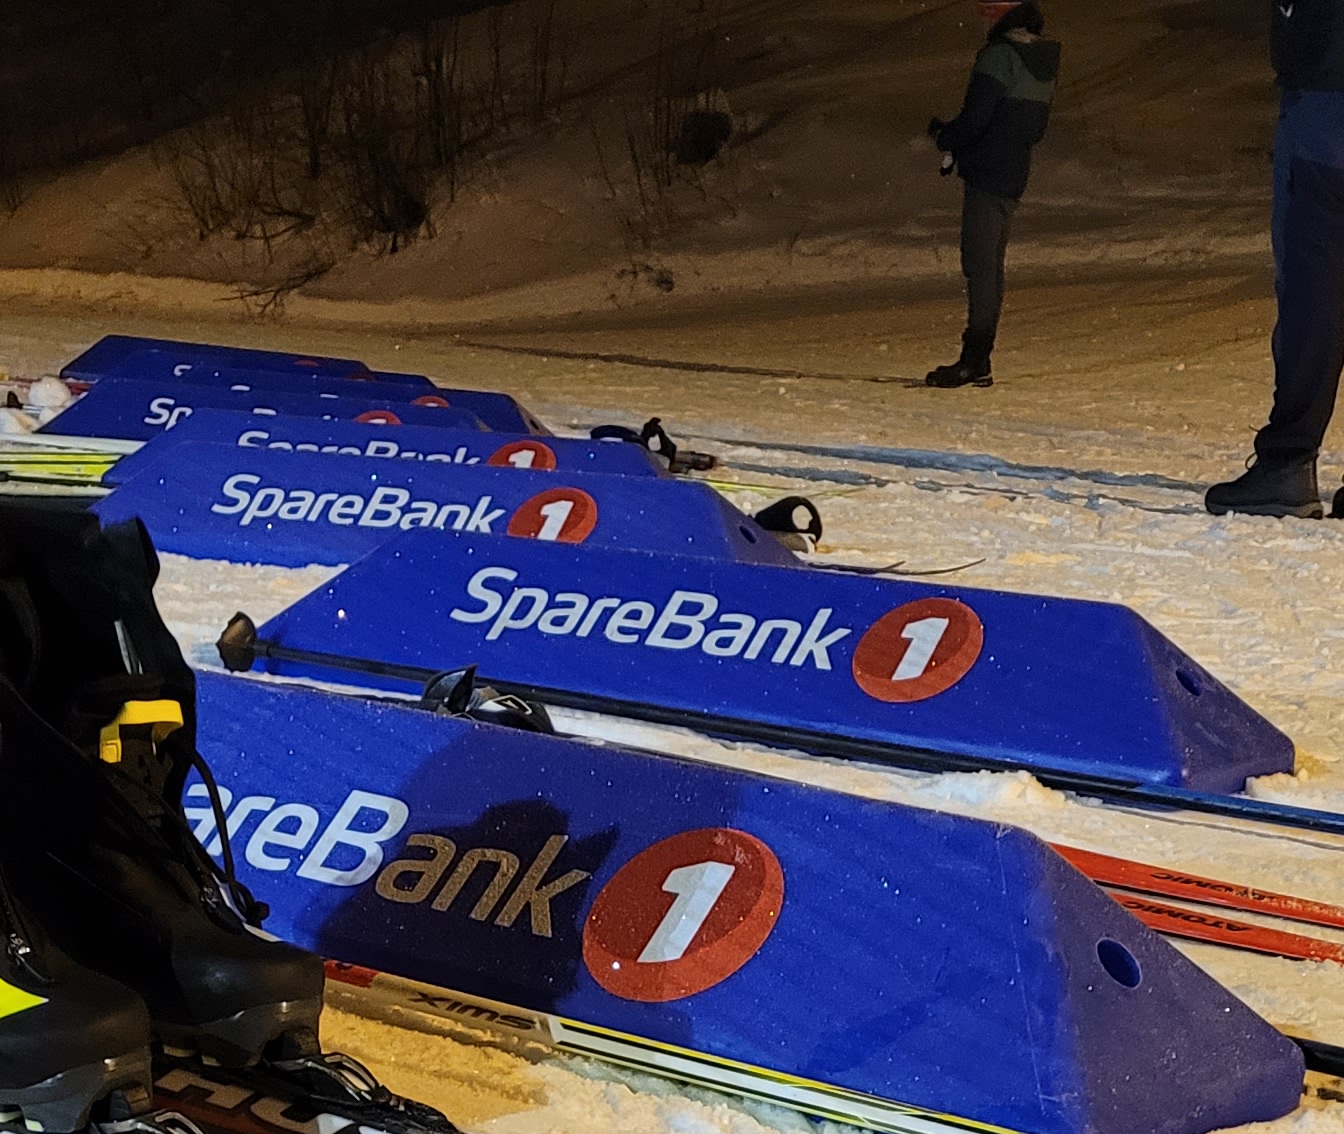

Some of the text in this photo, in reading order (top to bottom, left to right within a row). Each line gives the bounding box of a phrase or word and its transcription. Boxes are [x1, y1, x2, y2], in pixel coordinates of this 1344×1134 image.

[210, 473, 575, 541] SpareBank 1
[449, 566, 950, 682] SpareBank 1
[182, 782, 736, 964] areBank 1
